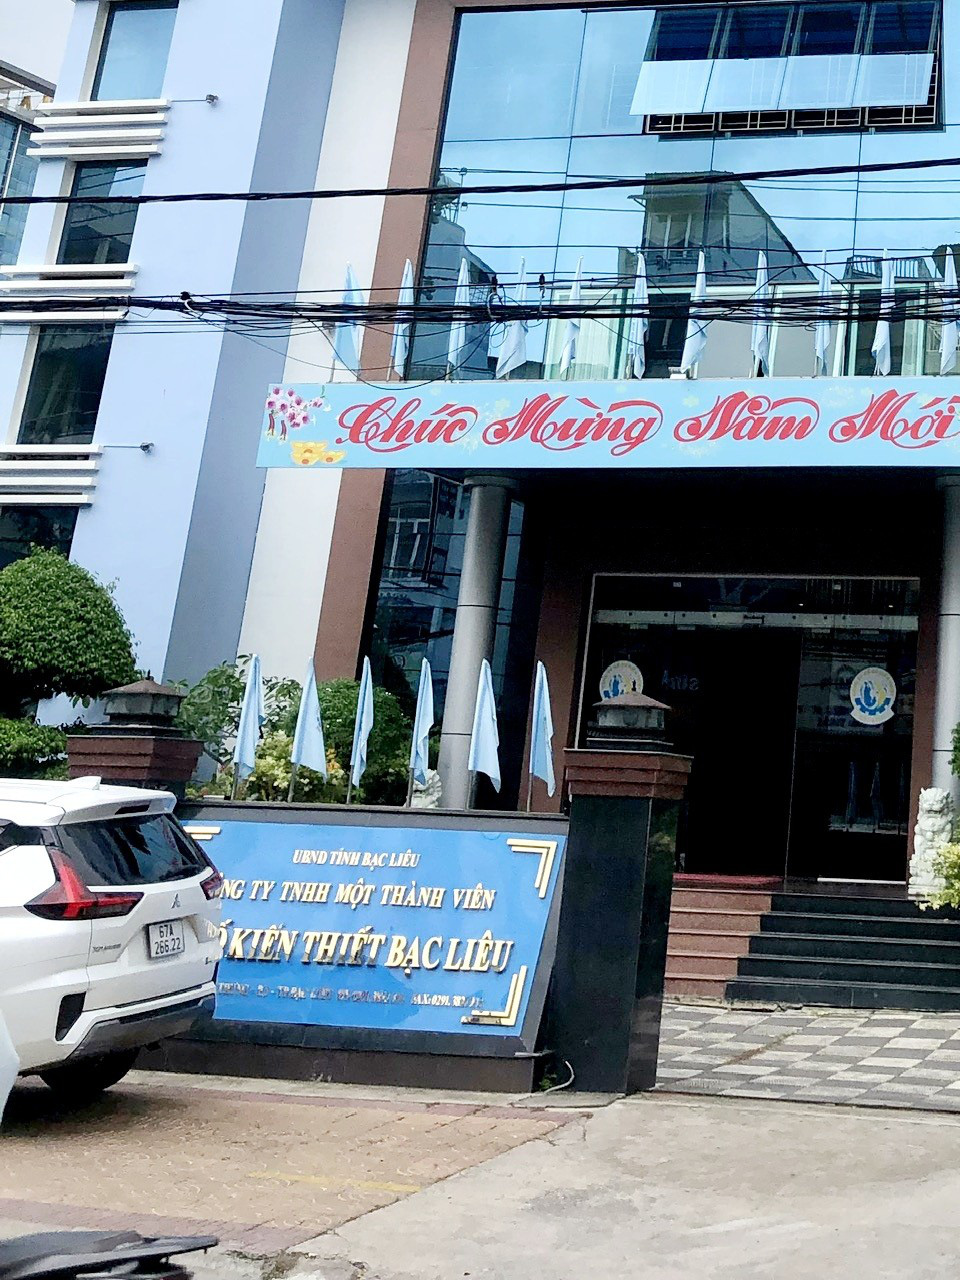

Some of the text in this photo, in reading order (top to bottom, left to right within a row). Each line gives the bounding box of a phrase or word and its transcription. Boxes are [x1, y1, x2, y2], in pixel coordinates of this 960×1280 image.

[335, 396, 479, 454] Chúc
[482, 392, 664, 457] Mừng
[673, 391, 820, 443] Năm
[292, 849, 328, 864] UBND
[361, 851, 389, 871] BẠC
[389, 849, 422, 868] LIÊU
[249, 879, 276, 901] TY
[280, 882, 329, 904] TNHH
[334, 878, 375, 910] MỘT
[380, 881, 444, 909] THÀNH
[452, 883, 498, 911] VIÊN
[159, 924, 174, 938] 67A
[155, 937, 181, 955] 266.22
[228, 923, 300, 962] KIẾN
[301, 926, 386, 966] THIẾT
[384, 935, 442, 977] BẠC
[443, 930, 515, 973] LIÊU
